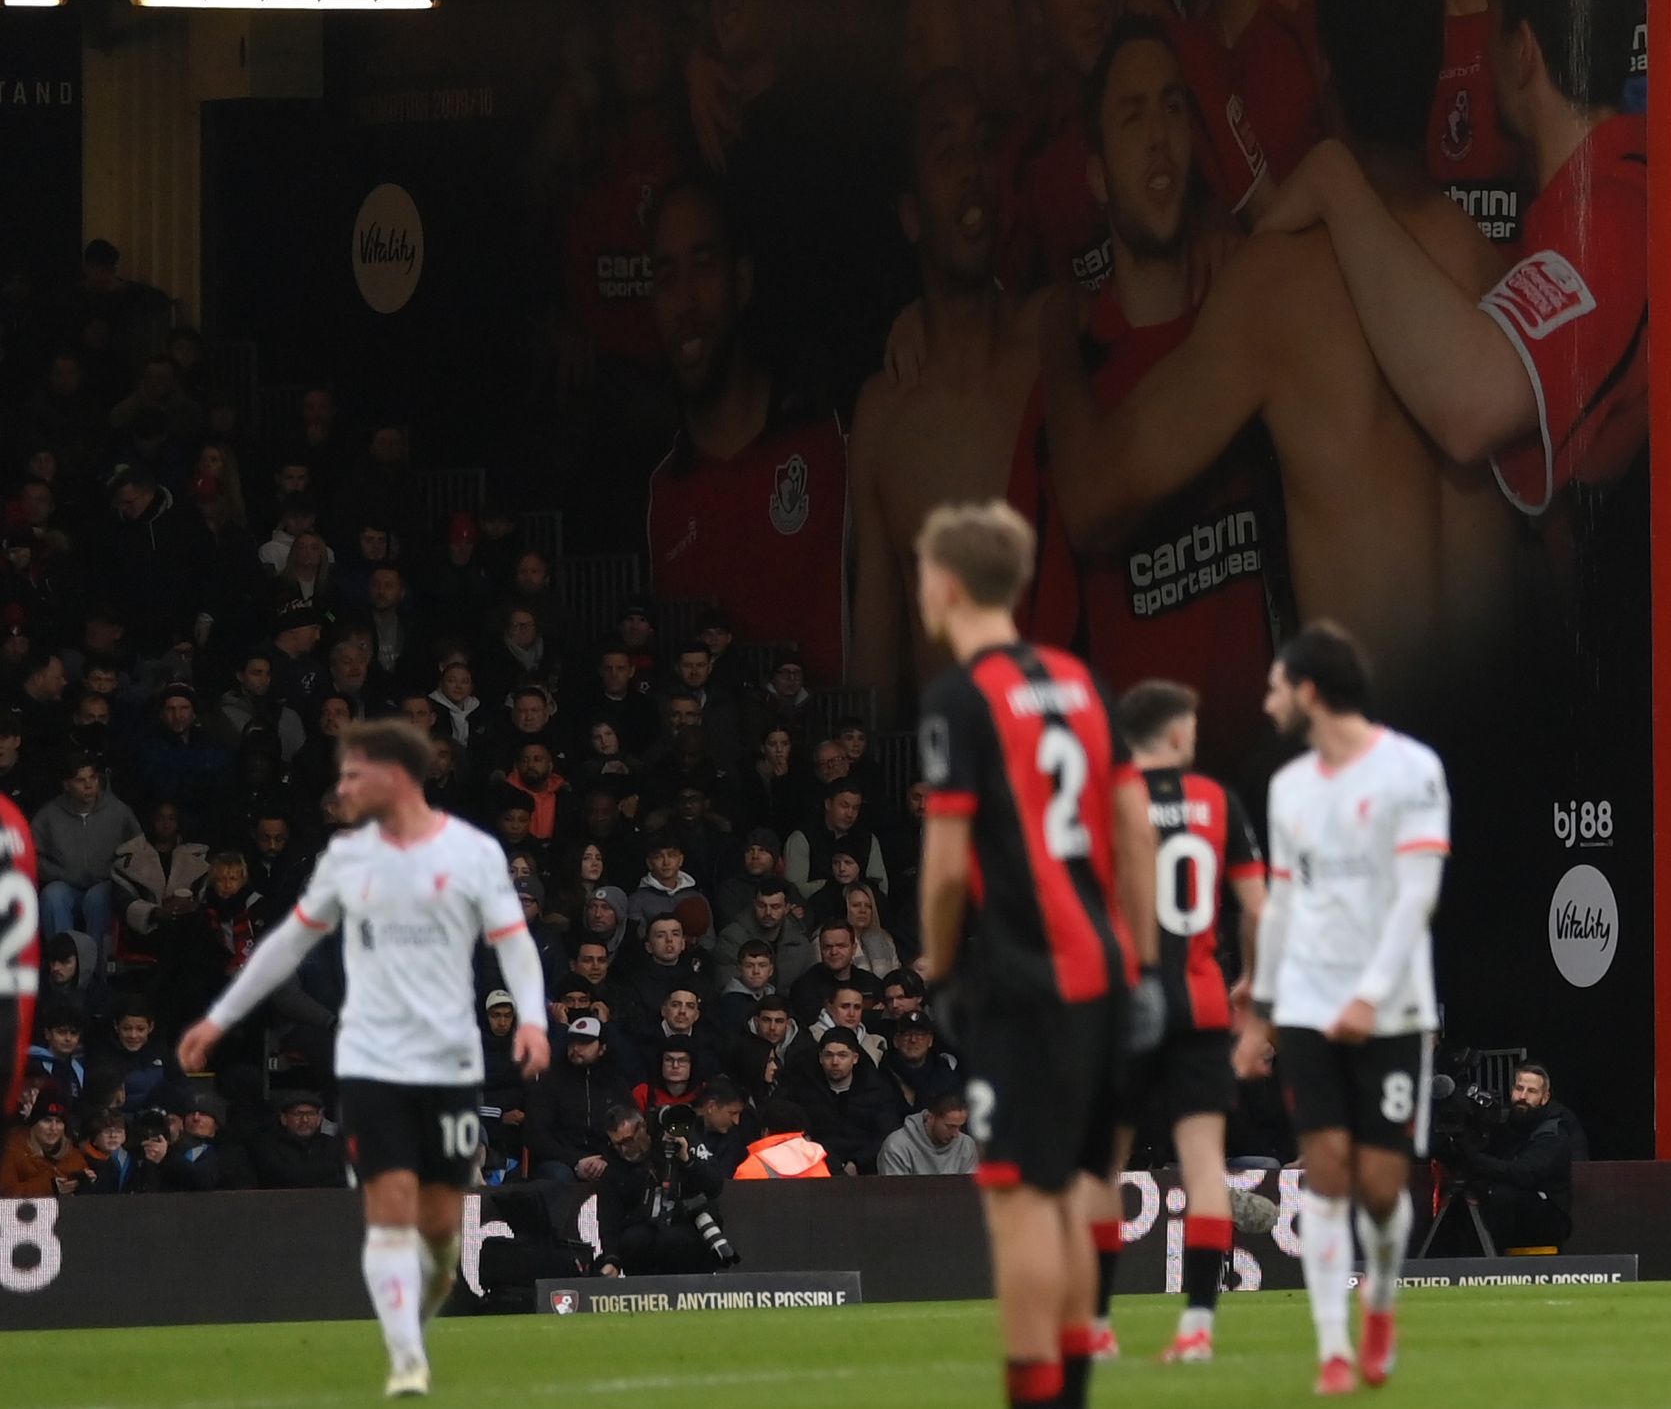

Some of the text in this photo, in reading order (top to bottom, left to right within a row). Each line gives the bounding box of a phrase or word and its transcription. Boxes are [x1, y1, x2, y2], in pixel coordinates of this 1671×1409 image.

[1444, 185, 1517, 218] brini
[360, 220, 416, 274] Vitality
[1036, 722, 1093, 861] 2
[1553, 800, 1615, 848] bj88
[1156, 833, 1218, 937] 0
[1556, 900, 1611, 961] Vitality
[1381, 1070, 1415, 1124] 8
[439, 1112, 481, 1157] 10
[676, 1292, 754, 1311] ANYTHING
[756, 1291, 772, 1308] IS
[774, 1290, 846, 1308] POSSIBLE
